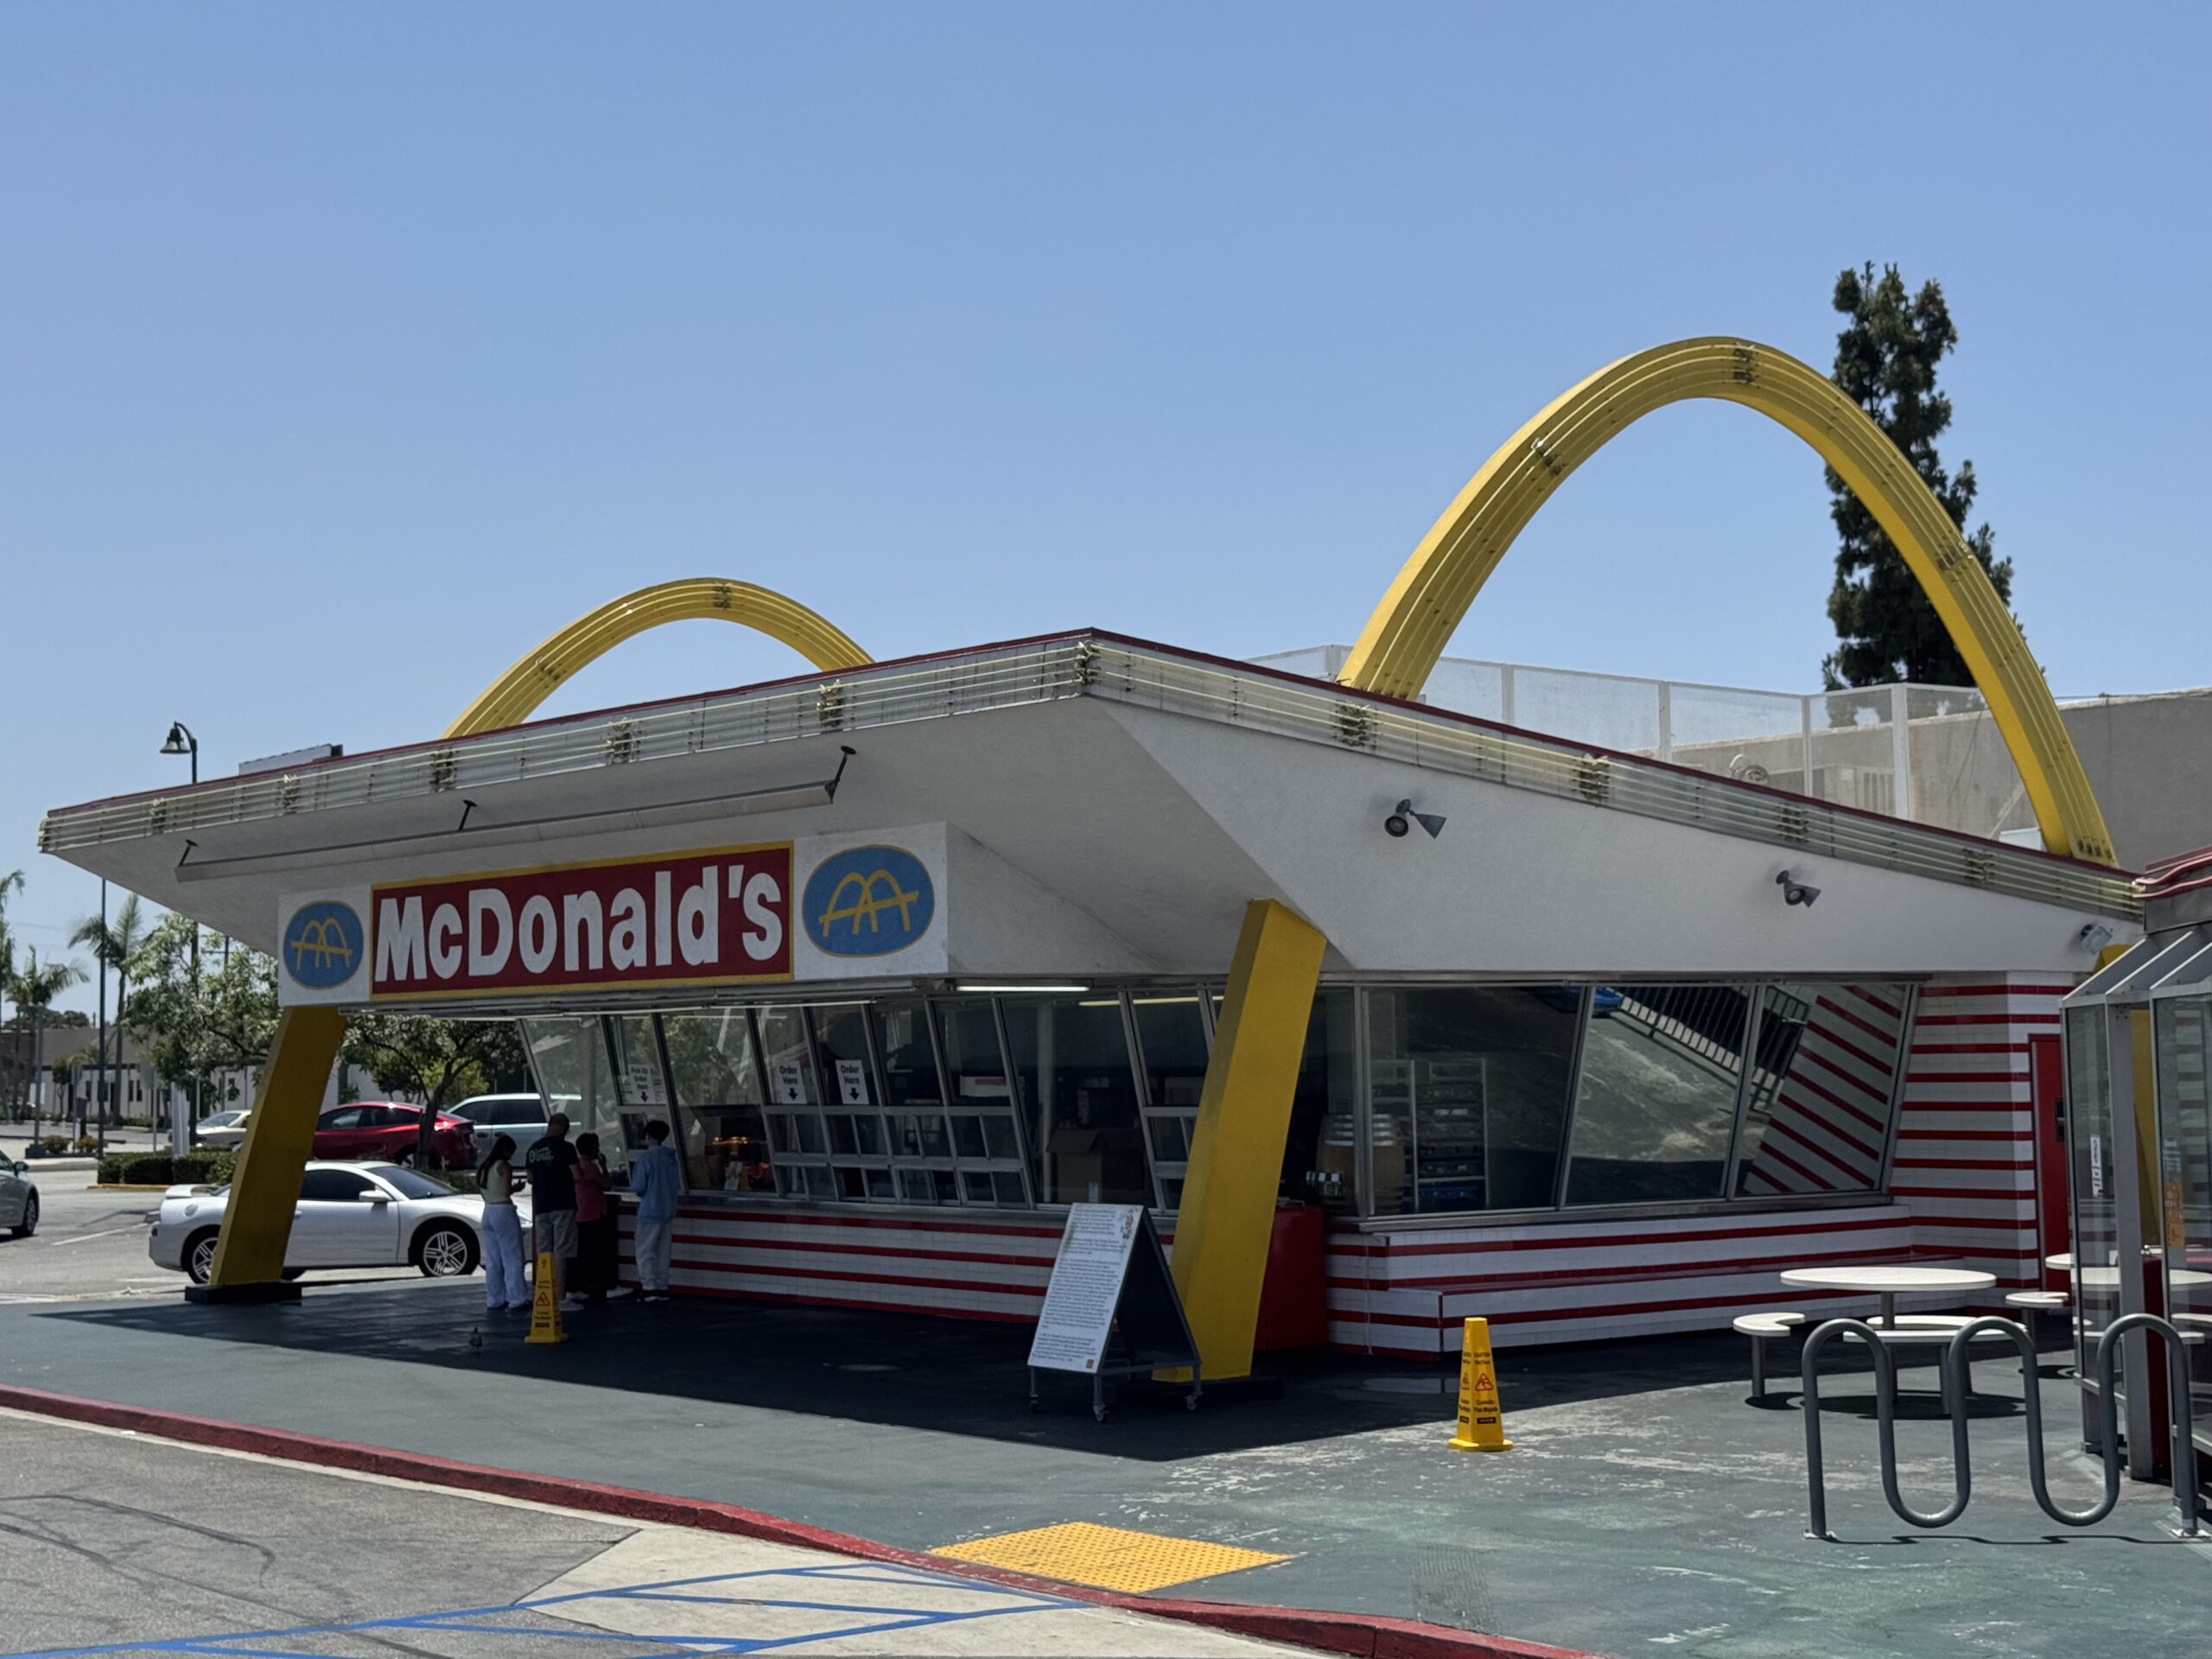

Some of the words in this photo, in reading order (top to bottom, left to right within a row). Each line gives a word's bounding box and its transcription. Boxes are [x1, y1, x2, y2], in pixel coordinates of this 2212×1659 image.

[374, 865, 783, 982] McDonald's
[779, 1065, 798, 1074] Order
[841, 1065, 860, 1074] Order
[783, 1076, 798, 1084] Here
